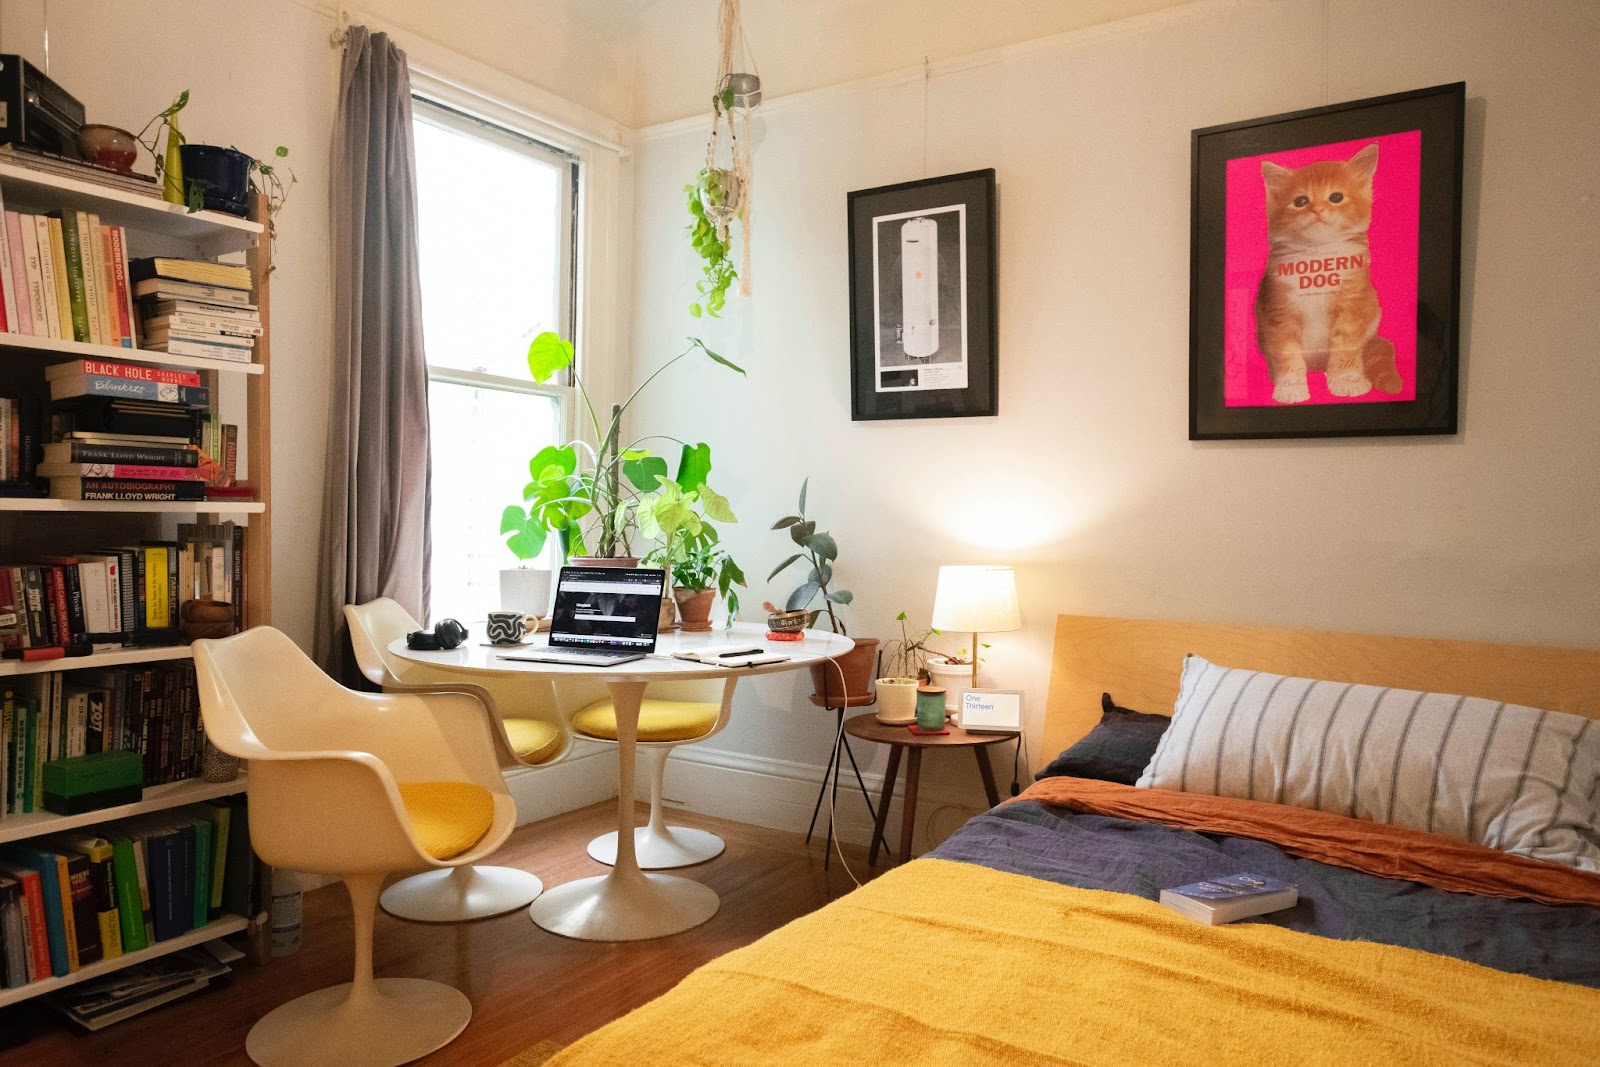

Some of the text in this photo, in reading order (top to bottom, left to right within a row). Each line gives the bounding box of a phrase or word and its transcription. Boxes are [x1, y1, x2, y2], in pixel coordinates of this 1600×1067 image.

[68, 228, 77, 262] EVIDENCE
[82, 232, 93, 282] EXPLANATIONS
[111, 229, 124, 281] MODERN DOG
[1277, 254, 1364, 276] MODERN
[1299, 272, 1341, 290] DOG
[87, 284, 96, 307] VISUAL
[85, 362, 152, 381] BLACK HOLE
[157, 371, 186, 380] CHARLES
[94, 380, 146, 394] Blankets
[82, 450, 109, 460] FRANK
[111, 452, 135, 461] LLOYD
[136, 452, 165, 462] WRIGHT
[85, 482, 176, 491] AN AUTOBIOGRAPHY
[85, 492, 113, 501] FRANK
[114, 492, 143, 501] LLOYD
[143, 492, 176, 501] WRIGHT
[58, 590, 66, 610] CAMUS
[72, 591, 81, 618] Physics
[965, 694, 981, 702] One
[965, 702, 994, 711] Thirteen
[89, 700, 103, 733] ZOT!
